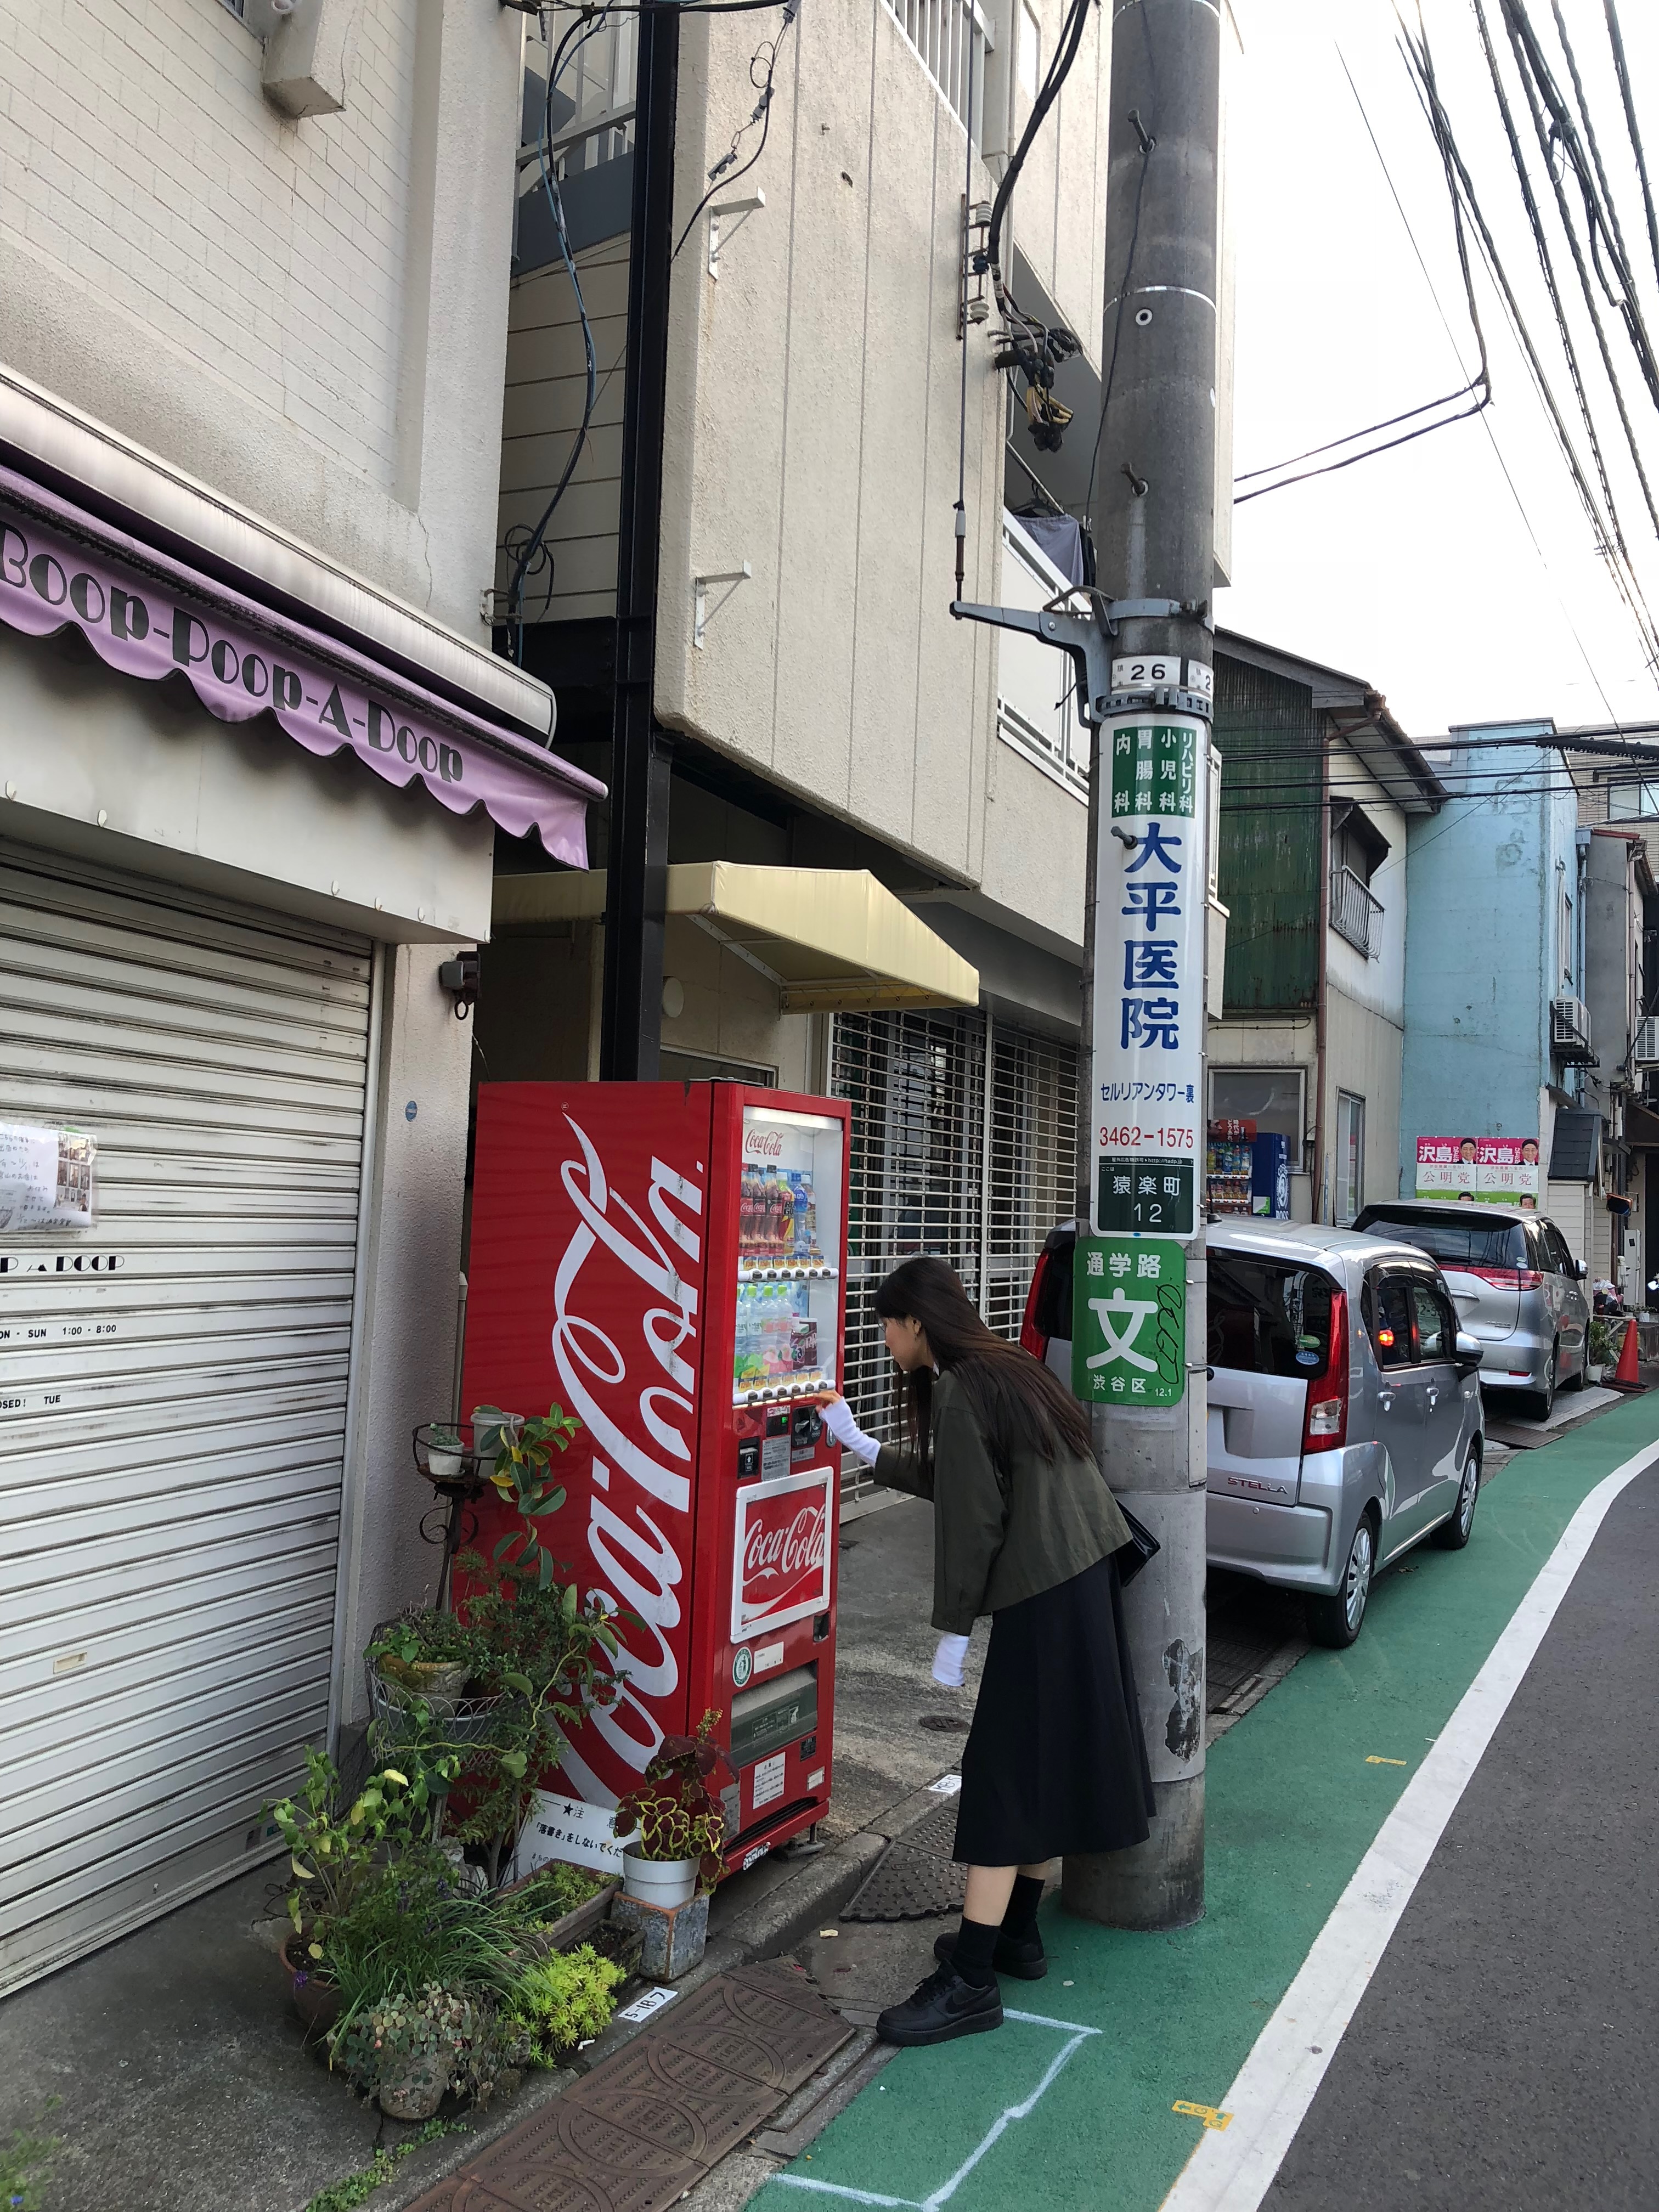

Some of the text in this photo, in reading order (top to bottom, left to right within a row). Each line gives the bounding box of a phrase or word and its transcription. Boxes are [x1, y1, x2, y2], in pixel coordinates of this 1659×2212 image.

[1131, 664, 1166, 680] 26
[1135, 729, 1153, 812] 胃腸科
[1159, 729, 1177, 812] 小児科
[1179, 732, 1194, 814] リハビリ科
[1120, 822, 1182, 1050] 大平医院
[1101, 1082, 1194, 1104] セルリアンタワー裏
[1099, 1126, 1193, 1148] 3462-1575
[1418, 1146, 1453, 1163] 沢島
[1479, 1147, 1514, 1164] 沢島
[1113, 1175, 1181, 1196] 猿楽町
[1423, 1171, 1470, 1184] 公明党
[1483, 1172, 1532, 1186] 公明党
[1133, 1203, 1163, 1223] 12
[56, 1255, 125, 1272] DOOP
[1087, 1251, 1161, 1279] 通学路
[28, 1328, 47, 1338] SUN
[63, 1327, 82, 1335] 1:00
[96, 1324, 116, 1334] 8:00
[1093, 1374, 1147, 1393] 渋谷区
[1155, 1388, 1172, 1397] 12.1
[44, 1395, 61, 1404] TUE
[1228, 1476, 1288, 1494] STELLA
